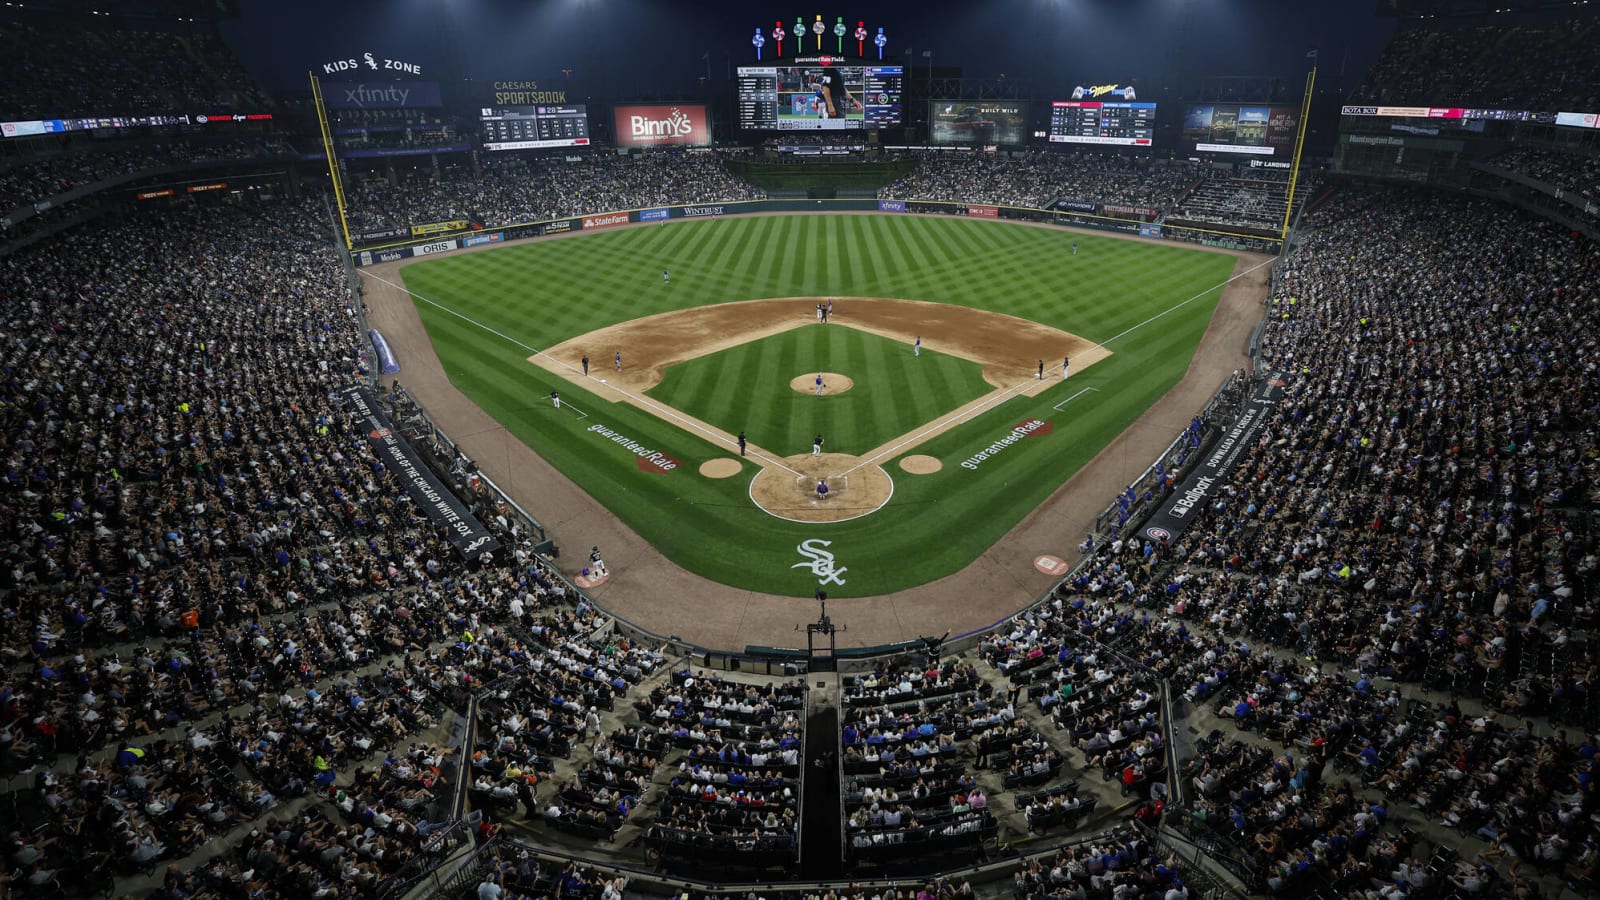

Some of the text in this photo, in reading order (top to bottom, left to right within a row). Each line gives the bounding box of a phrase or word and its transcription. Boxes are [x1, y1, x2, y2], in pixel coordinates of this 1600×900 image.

[323, 59, 359, 74] KIDS
[384, 59, 422, 75] ZONE
[494, 81, 537, 90] CAESARS
[1090, 84, 1119, 98] Miller
[345, 84, 409, 107] xfinity
[495, 91, 567, 105] SPORTSBOOK
[1349, 134, 1388, 146] Huntington
[1250, 160, 1263, 168] Lite
[684, 207, 724, 216] WINTRUST
[881, 202, 901, 211] xfinity
[423, 242, 448, 254] ORIS
[587, 424, 676, 470] guaranteed Rate
[960, 419, 1045, 470] guaranteed Rate
[1207, 438, 1235, 468] DOWNLOAD
[1229, 428, 1242, 439] AND
[388, 445, 402, 461] HOME
[399, 457, 411, 467] OF
[404, 464, 417, 479] THE
[413, 477, 442, 503] CHICAGO
[1178, 475, 1215, 508] Ballpark
[435, 501, 459, 523] WHITE
[453, 520, 474, 537] SOX
